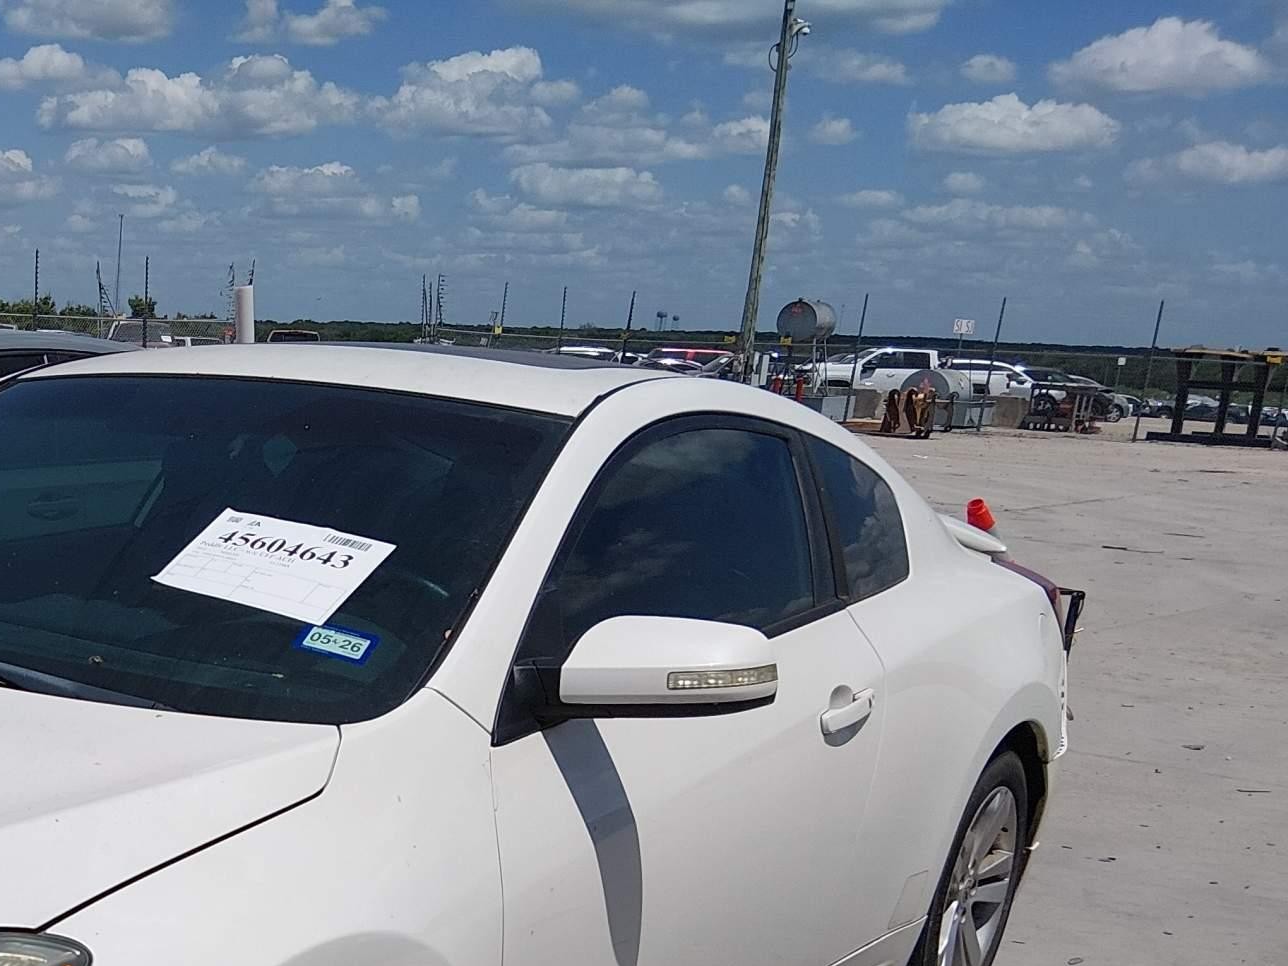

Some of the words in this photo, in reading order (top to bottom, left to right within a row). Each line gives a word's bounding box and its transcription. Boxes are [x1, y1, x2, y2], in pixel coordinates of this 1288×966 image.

[218, 530, 354, 569] 45604643
[309, 631, 333, 645] 05
[338, 639, 363, 653] 26
